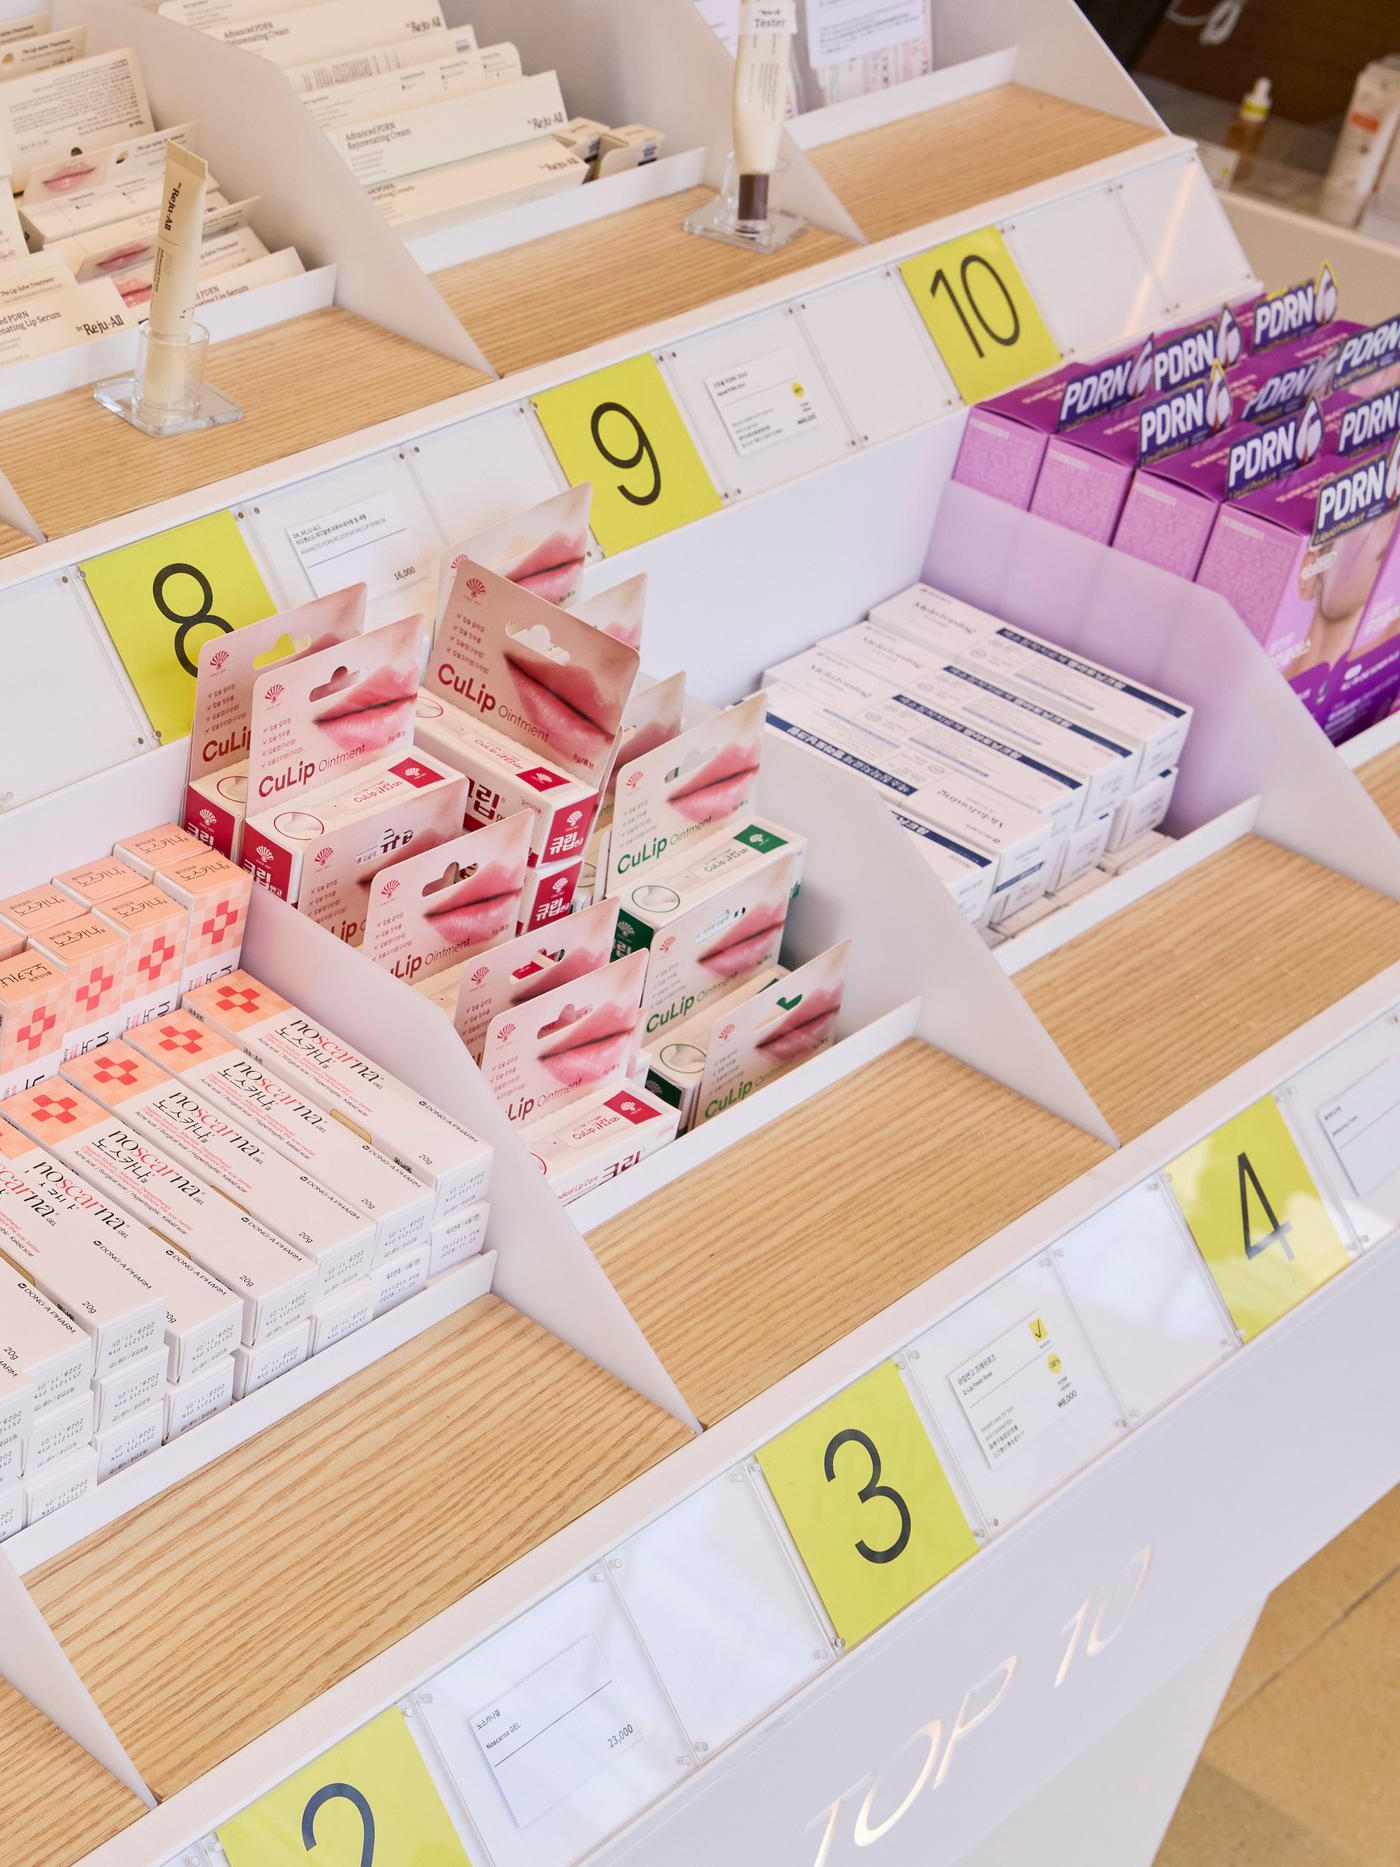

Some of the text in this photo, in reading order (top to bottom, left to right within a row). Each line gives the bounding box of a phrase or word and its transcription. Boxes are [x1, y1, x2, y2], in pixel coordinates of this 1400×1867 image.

[754, 18, 787, 30] Tester
[164, 187, 181, 231] Reju-All
[23, 321, 36, 332] Lip
[37, 310, 62, 327] Serum
[85, 315, 125, 336] Reju-All
[929, 254, 1021, 358] 10
[1253, 288, 1314, 345] PDRN
[1153, 327, 1215, 391] PDRN
[1060, 361, 1132, 423] PDRN
[1139, 386, 1204, 454] PDRN
[590, 402, 661, 506] 9
[1227, 424, 1295, 487] PDRN
[1316, 461, 1386, 530] PDRN
[394, 566, 416, 580] 16,000
[153, 562, 235, 678] 8
[438, 663, 550, 743] CuLip Ointment
[258, 761, 316, 797] CuLip
[318, 744, 366, 772] Ointment
[617, 816, 713, 875] CuLip Ointment
[424, 937, 471, 966] Ointment
[646, 995, 696, 1034] CuLip
[273, 1027, 333, 1065] 노스카나
[290, 1019, 383, 1083] noscarna
[233, 1060, 328, 1126] noscarna
[537, 1078, 582, 1108] Ointment
[704, 1079, 754, 1120] CuLip
[168, 1091, 262, 1157] noscarna
[91, 1138, 153, 1181] 노스카나
[107, 1129, 206, 1199] noscarna
[418, 1153, 433, 1166] 20g
[1237, 1152, 1292, 1261] 4
[127, 1266, 153, 1290] PHARM
[3, 1345, 19, 1362] 20g
[824, 1428, 911, 1564] 3
[803, 1545, 1153, 1867] TOP 10
[486, 1722, 521, 1750] Noscarna GEL
[608, 1724, 634, 1748] 23,000
[301, 1782, 375, 1867] 2
